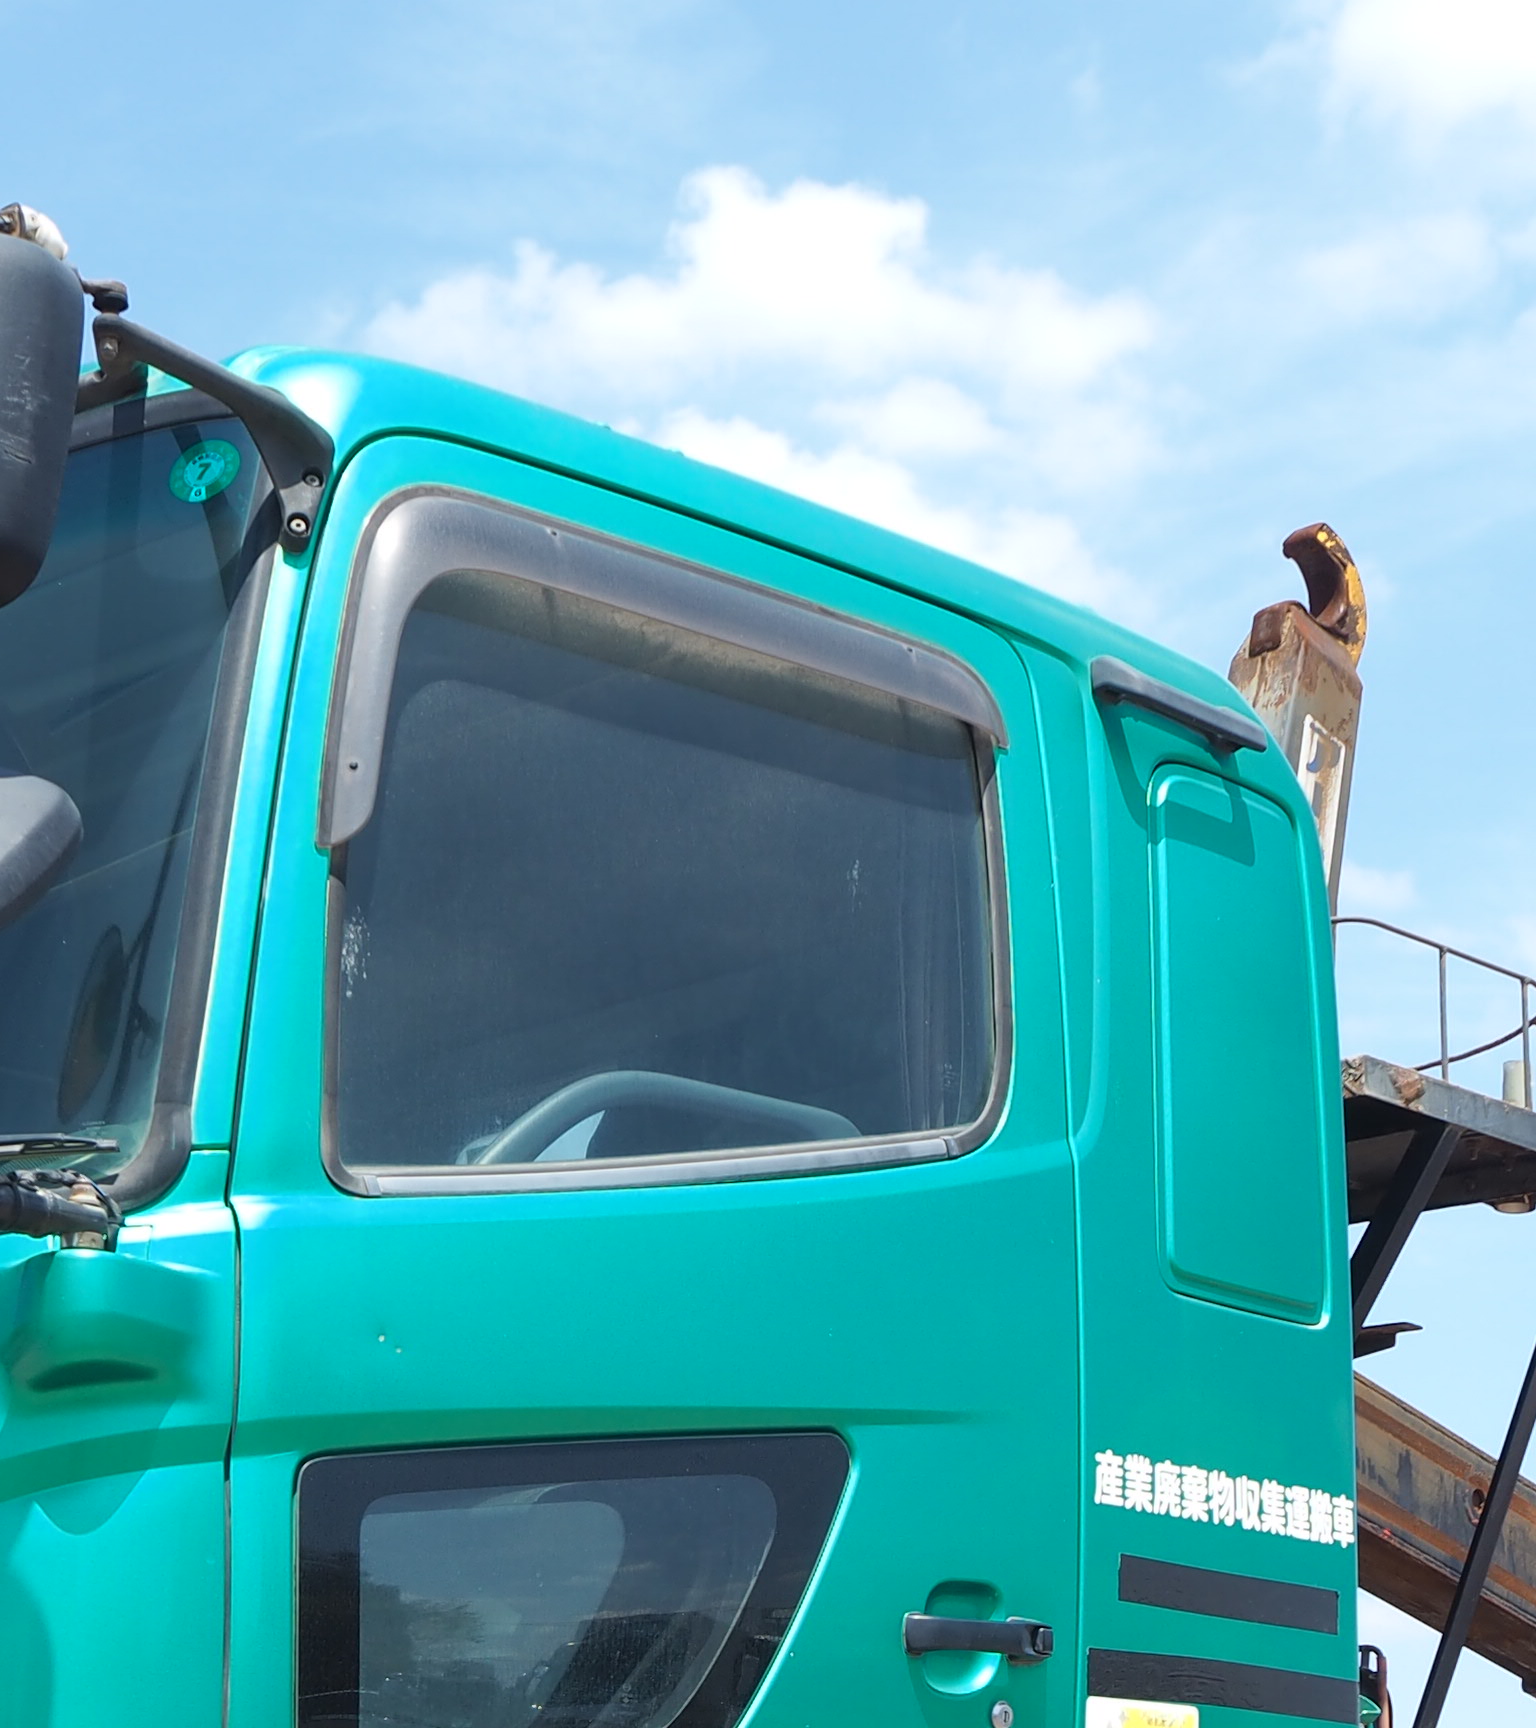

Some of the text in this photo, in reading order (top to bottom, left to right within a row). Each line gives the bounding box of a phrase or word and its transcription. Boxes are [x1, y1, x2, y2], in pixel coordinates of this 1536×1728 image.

[196, 461, 212, 481] 7
[1094, 1449, 1356, 1548] 産業廃棄物収集運搬車
